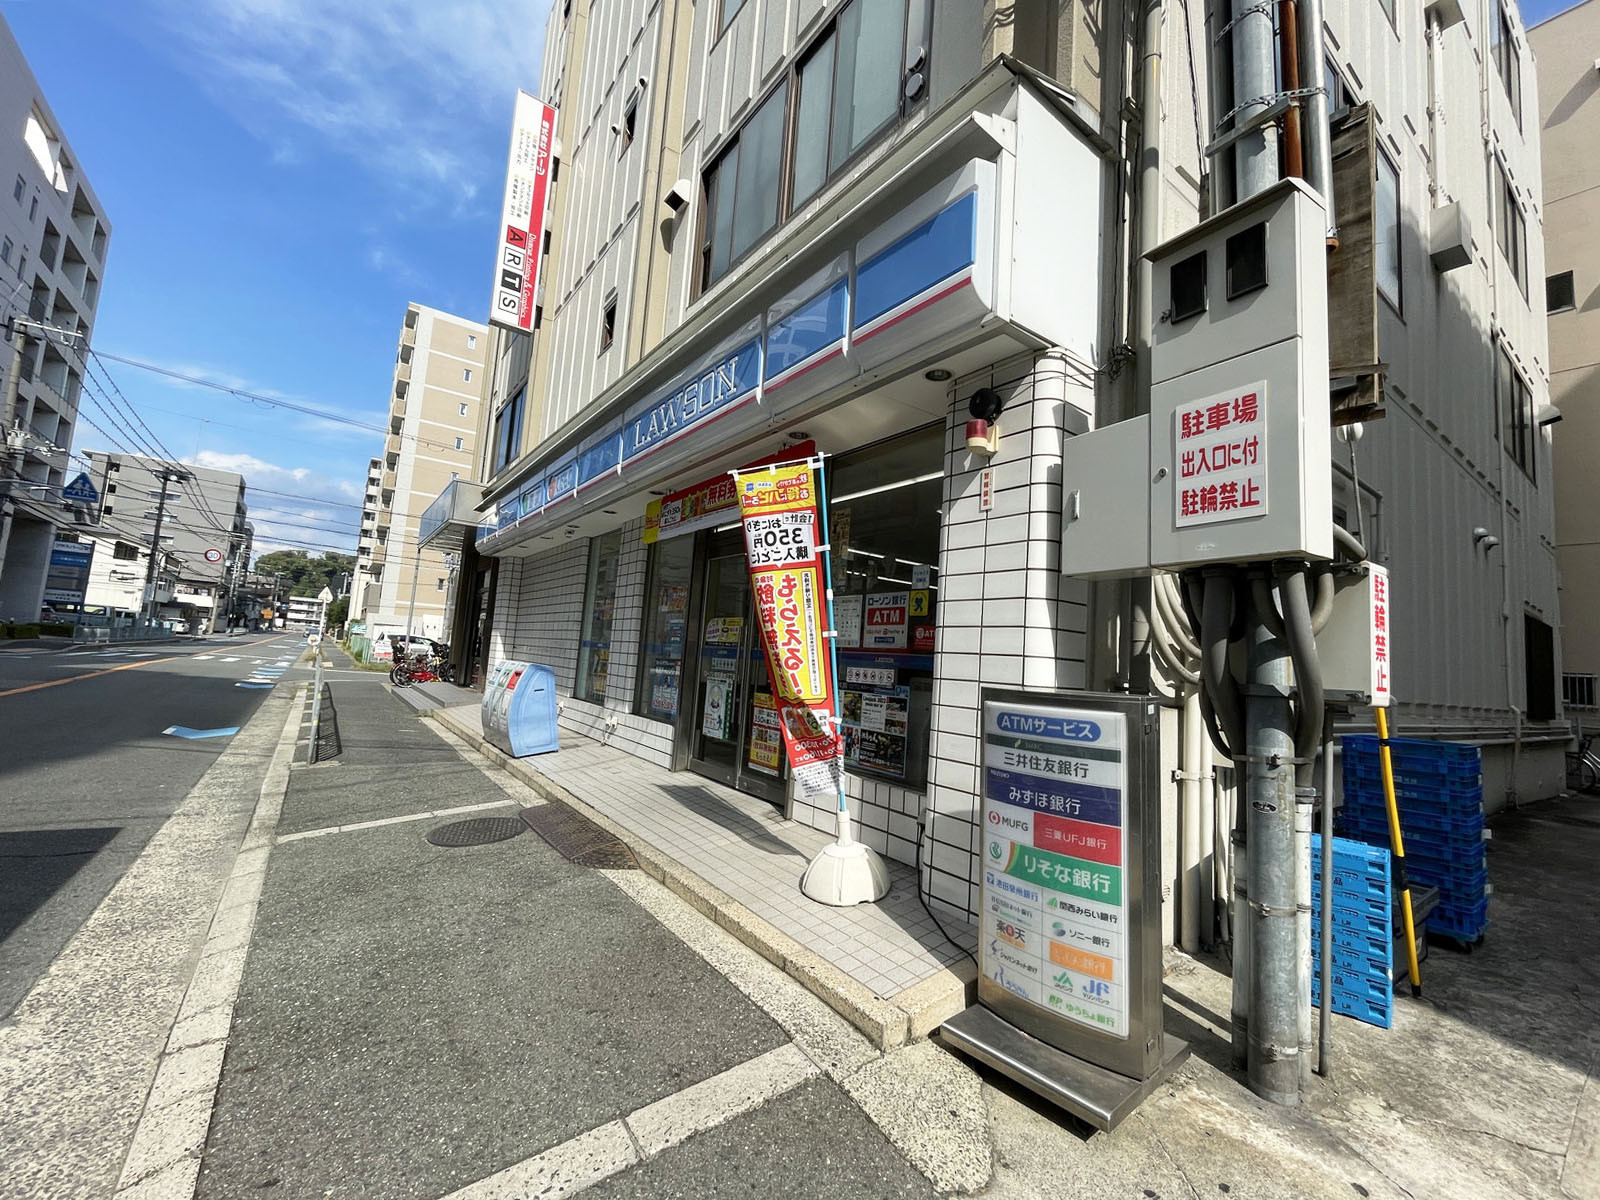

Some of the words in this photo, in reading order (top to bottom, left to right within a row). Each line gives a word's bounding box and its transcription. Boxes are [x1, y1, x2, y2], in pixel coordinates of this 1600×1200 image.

[502, 229, 524, 309] ARTS
[632, 356, 738, 451] LAWSON
[1181, 393, 1258, 439] 駐車場
[1181, 435, 1259, 478] 出入口に付
[1181, 478, 1260, 516] 駐輪禁止
[868, 595, 907, 606] ローソン銀行
[873, 610, 900, 623] ATM
[924, 630, 936, 638] AT
[1374, 574, 1387, 692] 駐輪禁止
[1001, 715, 1093, 739] ATMサービス
[1004, 752, 1089, 778] 三井住友銀行
[1009, 786, 1081, 815] みずほ銀行
[1001, 816, 1029, 832] MUFG
[1043, 827, 1107, 850] 三菱UFJ銀行
[1024, 855, 1111, 894] りそな銀行
[1059, 901, 1118, 924] 関西みらい銀行
[1069, 929, 1111, 948] ソニー銀行
[1065, 1002, 1115, 1028] ゆうちょ銀行
